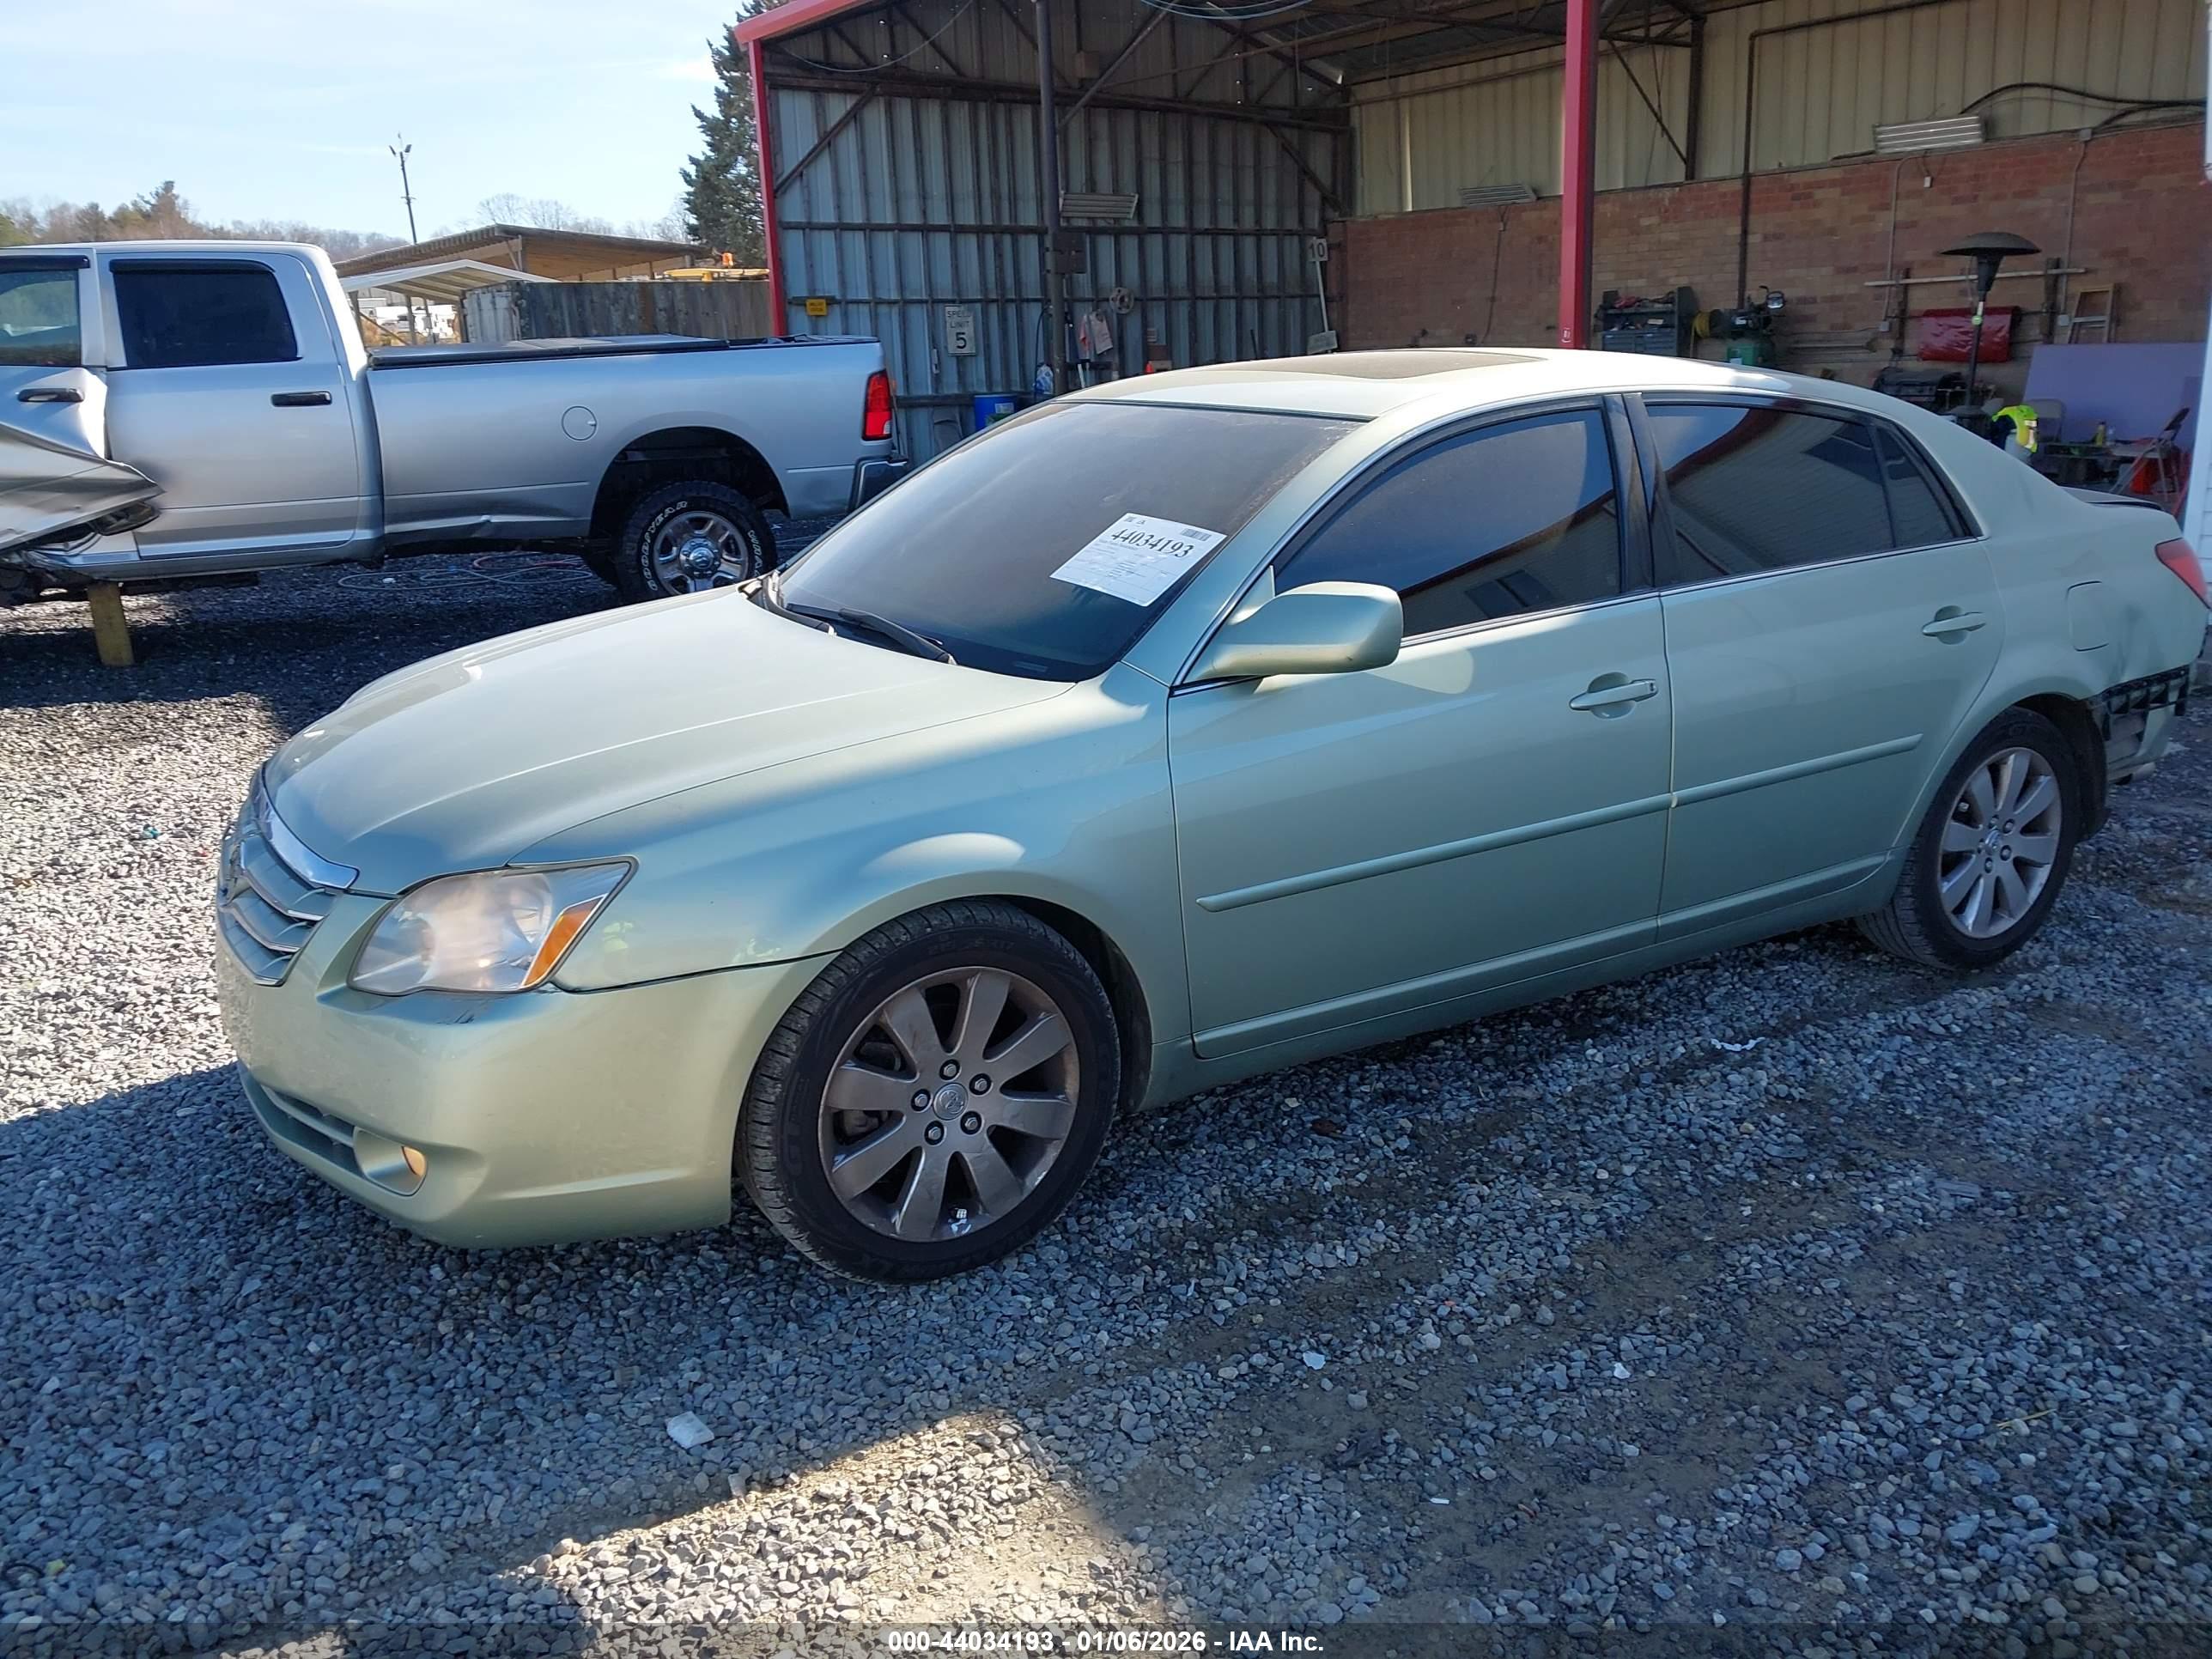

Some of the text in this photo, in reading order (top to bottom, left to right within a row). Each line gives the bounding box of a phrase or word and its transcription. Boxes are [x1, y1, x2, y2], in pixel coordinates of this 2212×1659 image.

[1309, 242, 1325, 258] 10
[955, 331, 967, 349] 5
[641, 501, 687, 591] GOODYEAR
[1111, 528, 1194, 558] 44034193
